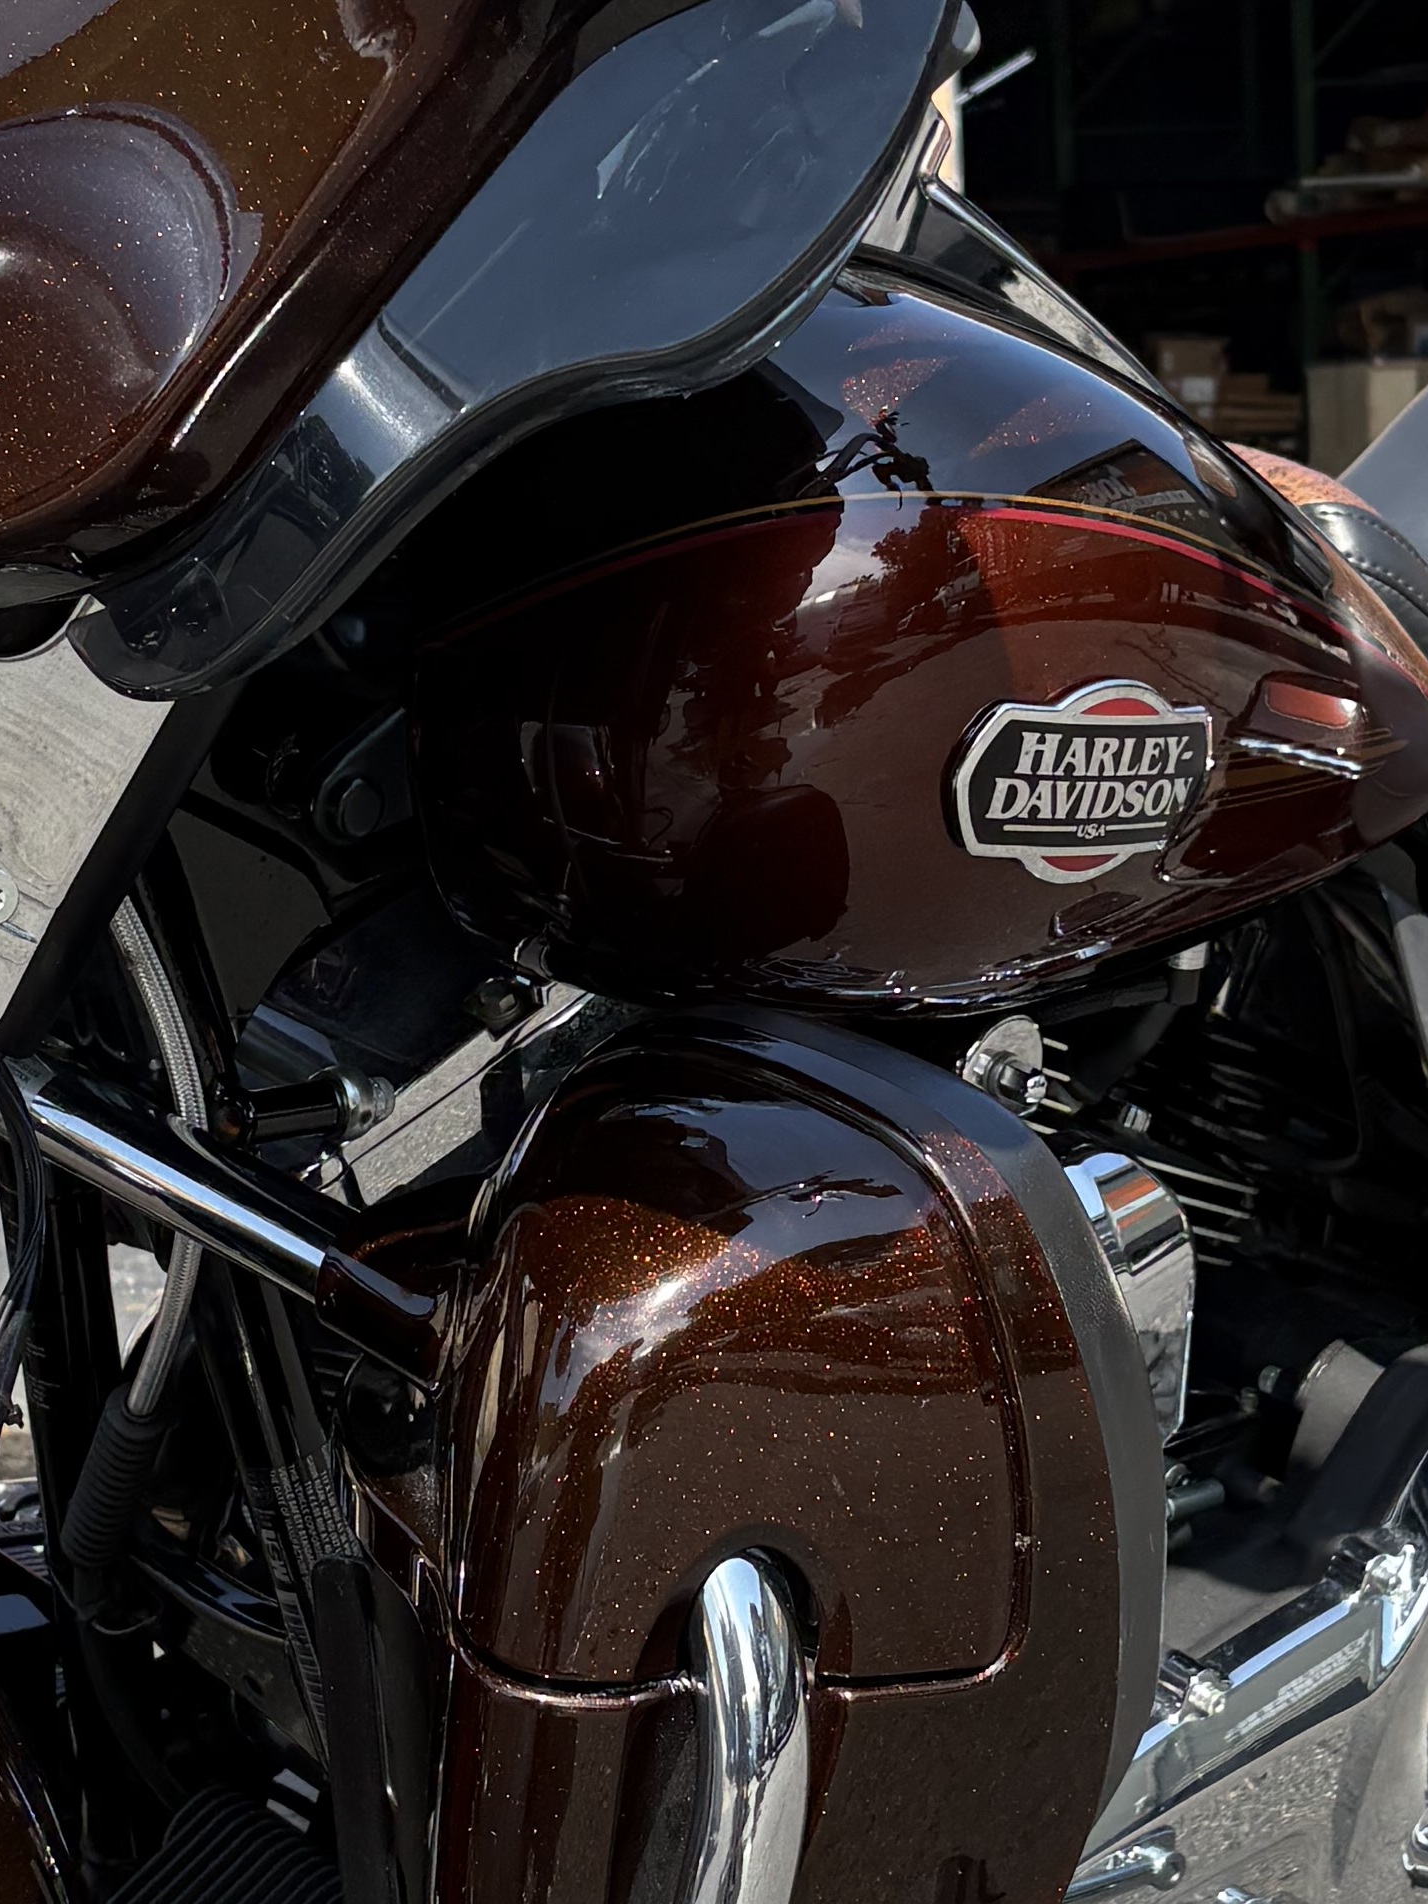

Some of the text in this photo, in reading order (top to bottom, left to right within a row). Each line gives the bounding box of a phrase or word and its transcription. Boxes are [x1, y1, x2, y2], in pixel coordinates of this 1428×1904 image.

[1013, 731, 1195, 777] HARLEY-
[984, 776, 1194, 821] DAVIDSON
[1076, 823, 1106, 840] USA
